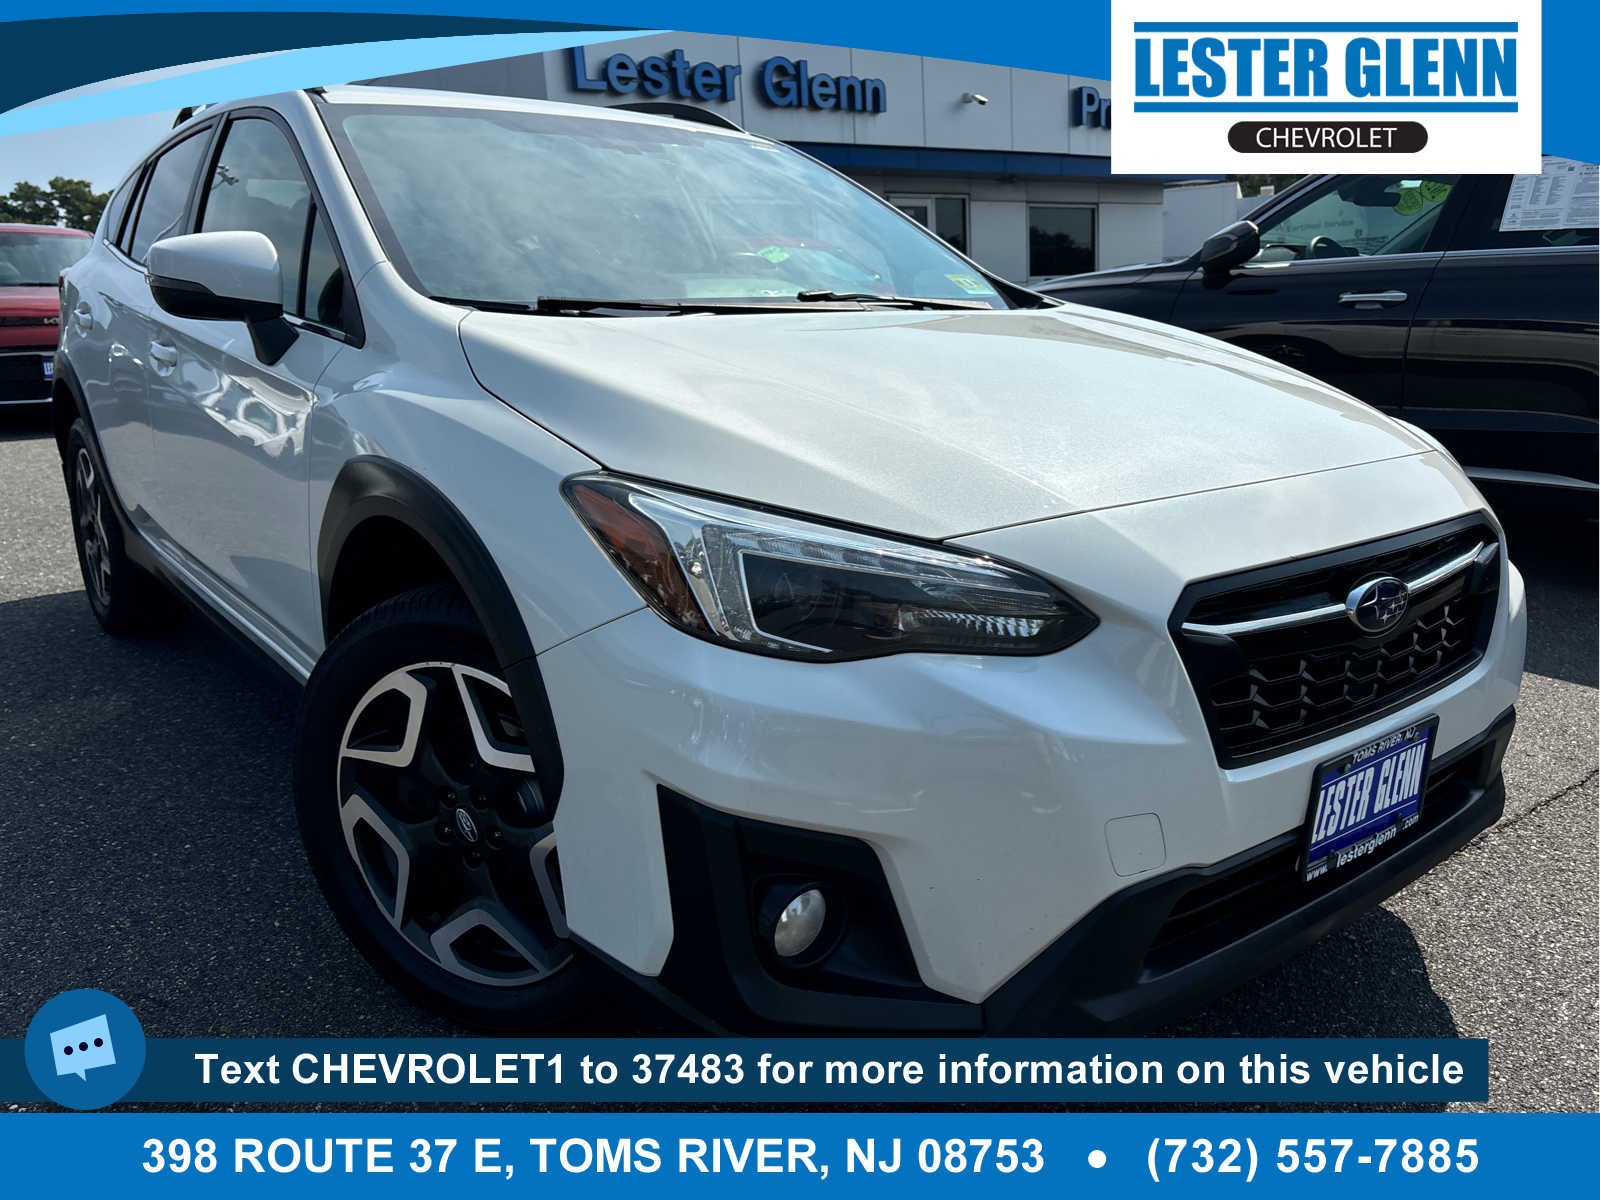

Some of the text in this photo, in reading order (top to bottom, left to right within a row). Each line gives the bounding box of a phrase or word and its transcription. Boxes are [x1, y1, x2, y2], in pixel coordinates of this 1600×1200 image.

[569, 46, 888, 113] Lester Glenn
[1353, 744, 1378, 764] TOMS
[1311, 742, 1427, 845] LESTER GLENN
[1336, 826, 1398, 868] lesterglenn
